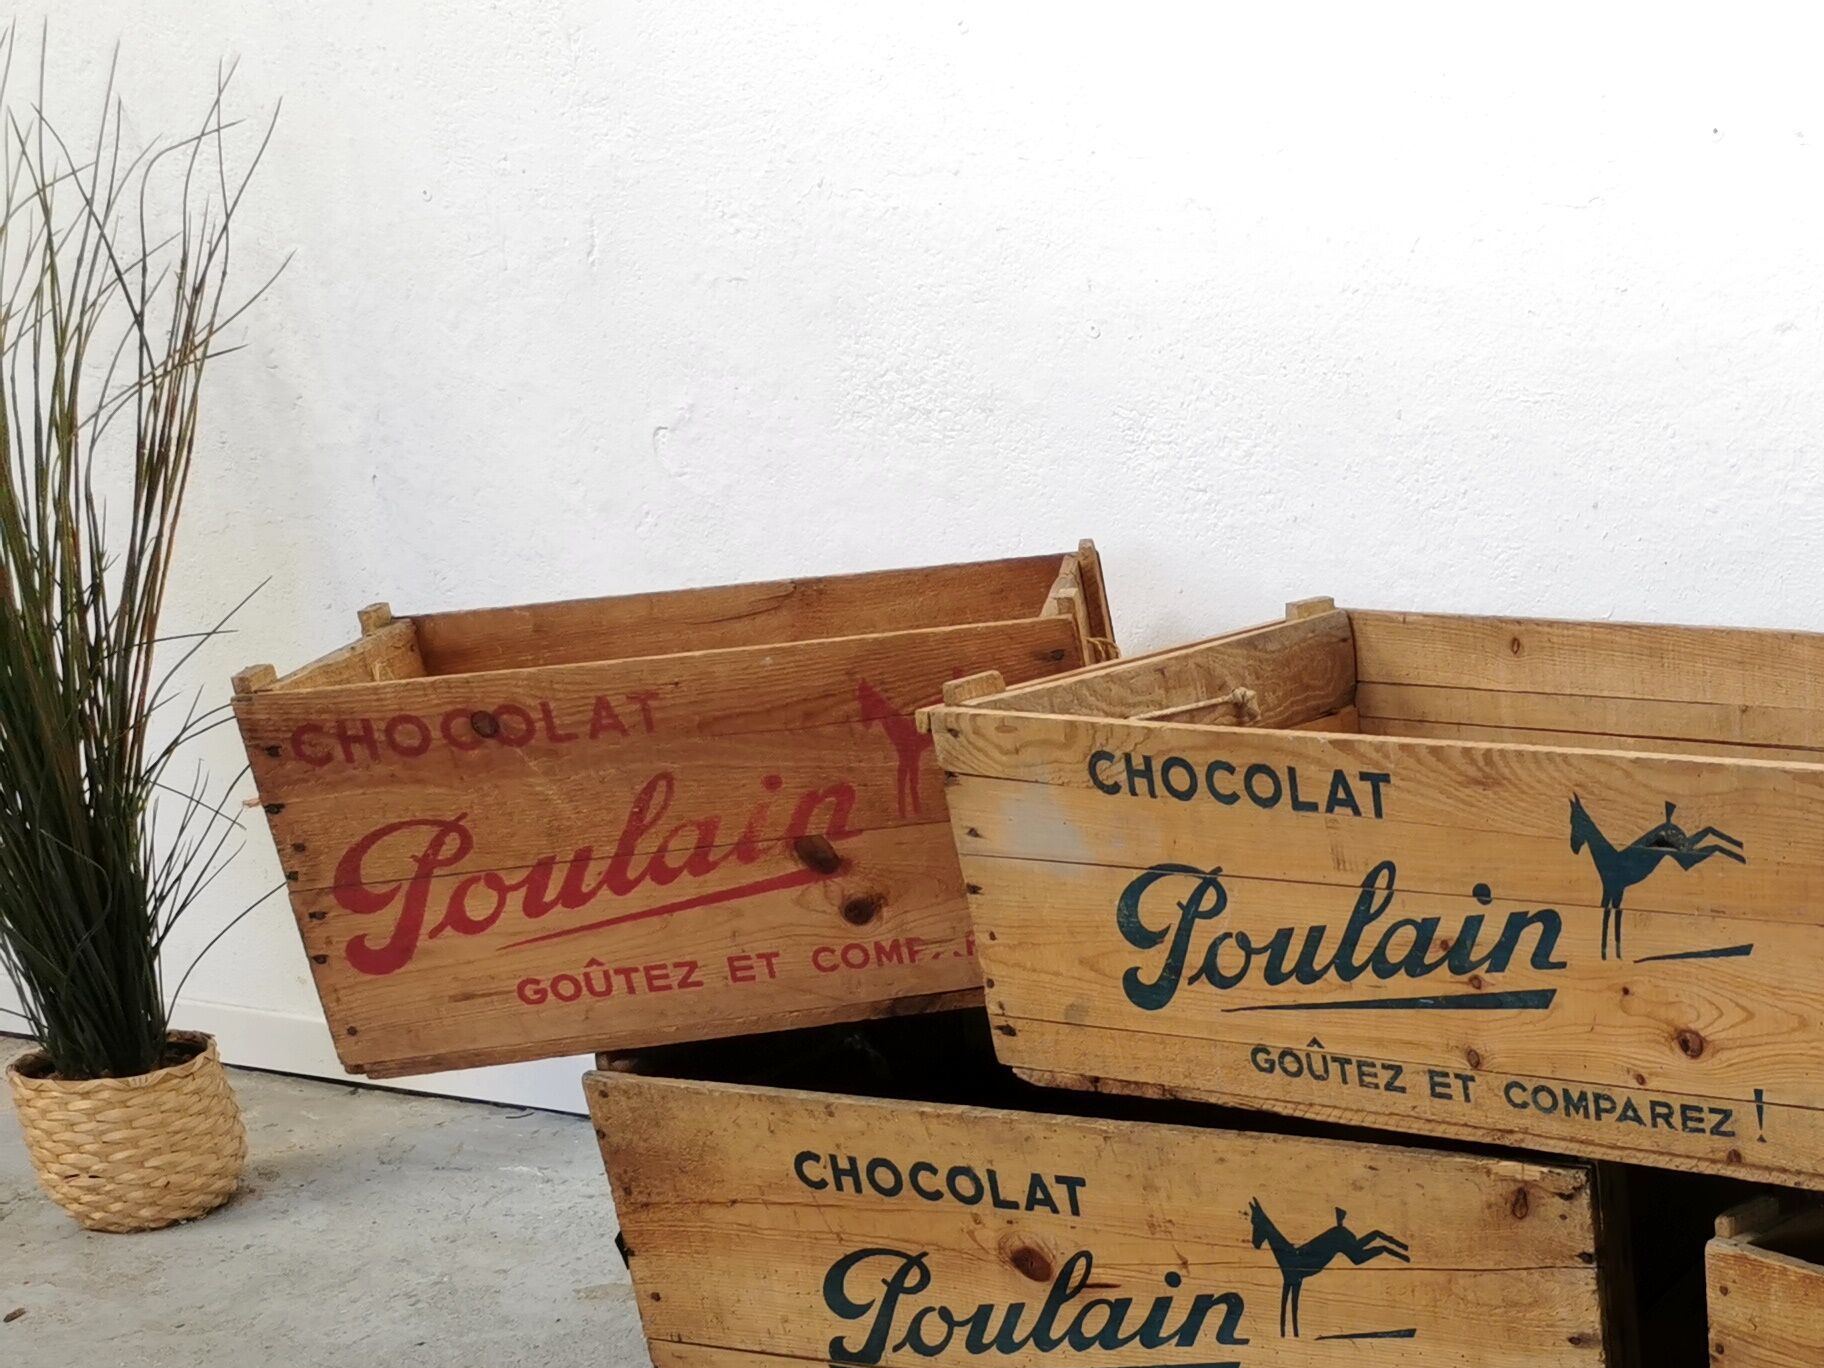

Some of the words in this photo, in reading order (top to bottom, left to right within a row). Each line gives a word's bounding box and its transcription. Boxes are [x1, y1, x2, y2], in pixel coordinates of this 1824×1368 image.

[289, 692, 660, 768] CHOCOLAT
[1088, 748, 1391, 820] CHOCOLAT
[333, 771, 862, 976] Poulain
[1115, 860, 1568, 1010] Poulain
[516, 957, 702, 1006] GOÛTEZ
[727, 951, 780, 981] ET
[1250, 1036, 1408, 1094] GOÛTEZ
[1429, 1070, 1475, 1101] ET
[1504, 1081, 1735, 1137] COMPAREZ
[794, 1150, 1087, 1217] CHOCOLAT
